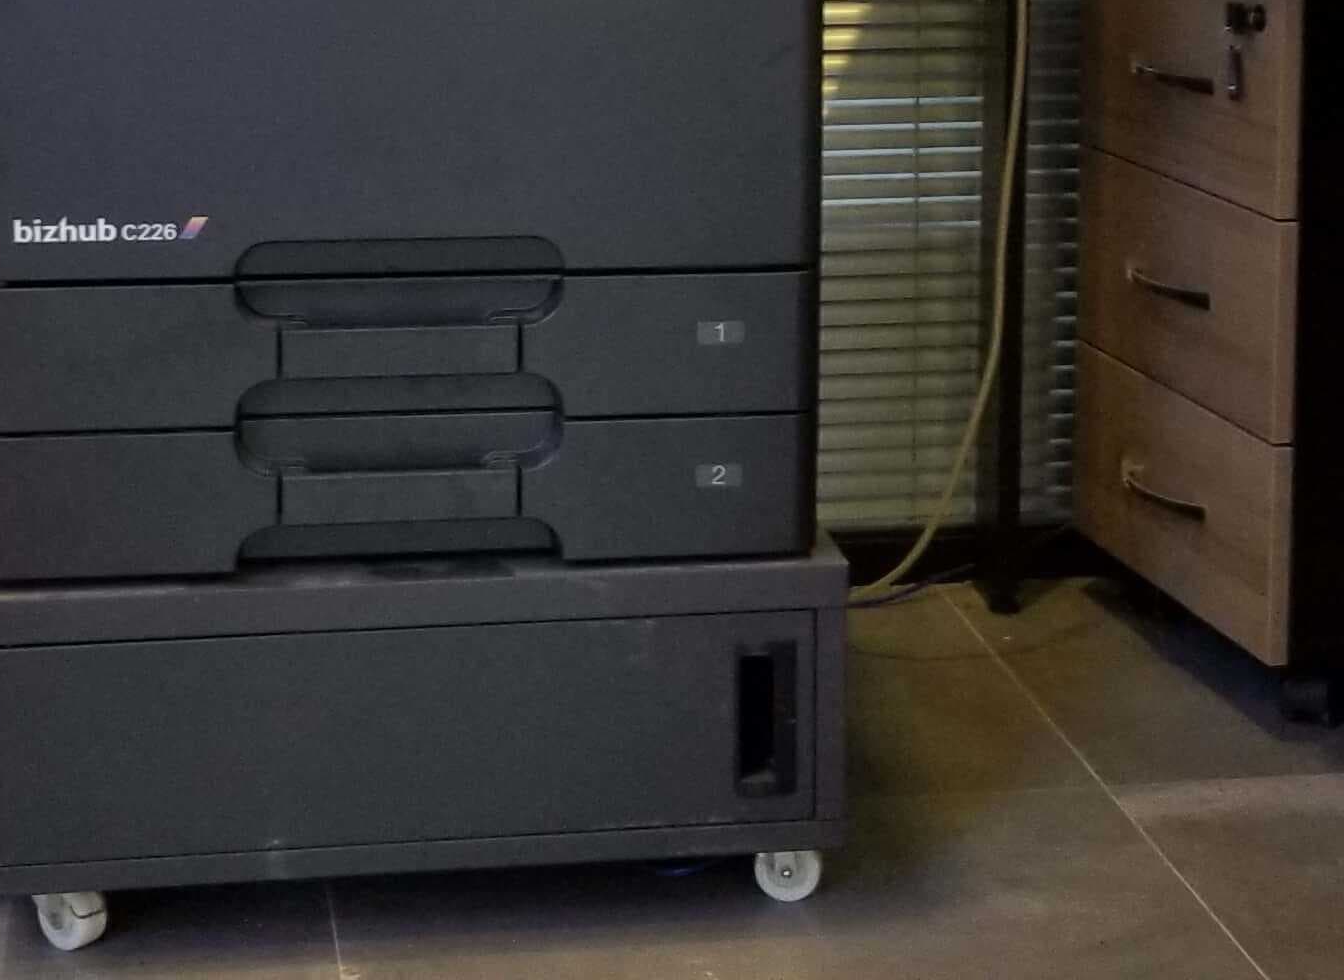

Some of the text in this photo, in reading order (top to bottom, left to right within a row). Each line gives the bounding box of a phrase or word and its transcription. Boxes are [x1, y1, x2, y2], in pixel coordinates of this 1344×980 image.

[13, 217, 177, 243] bizhub C226
[714, 323, 726, 342] 1
[712, 465, 726, 484] 2
